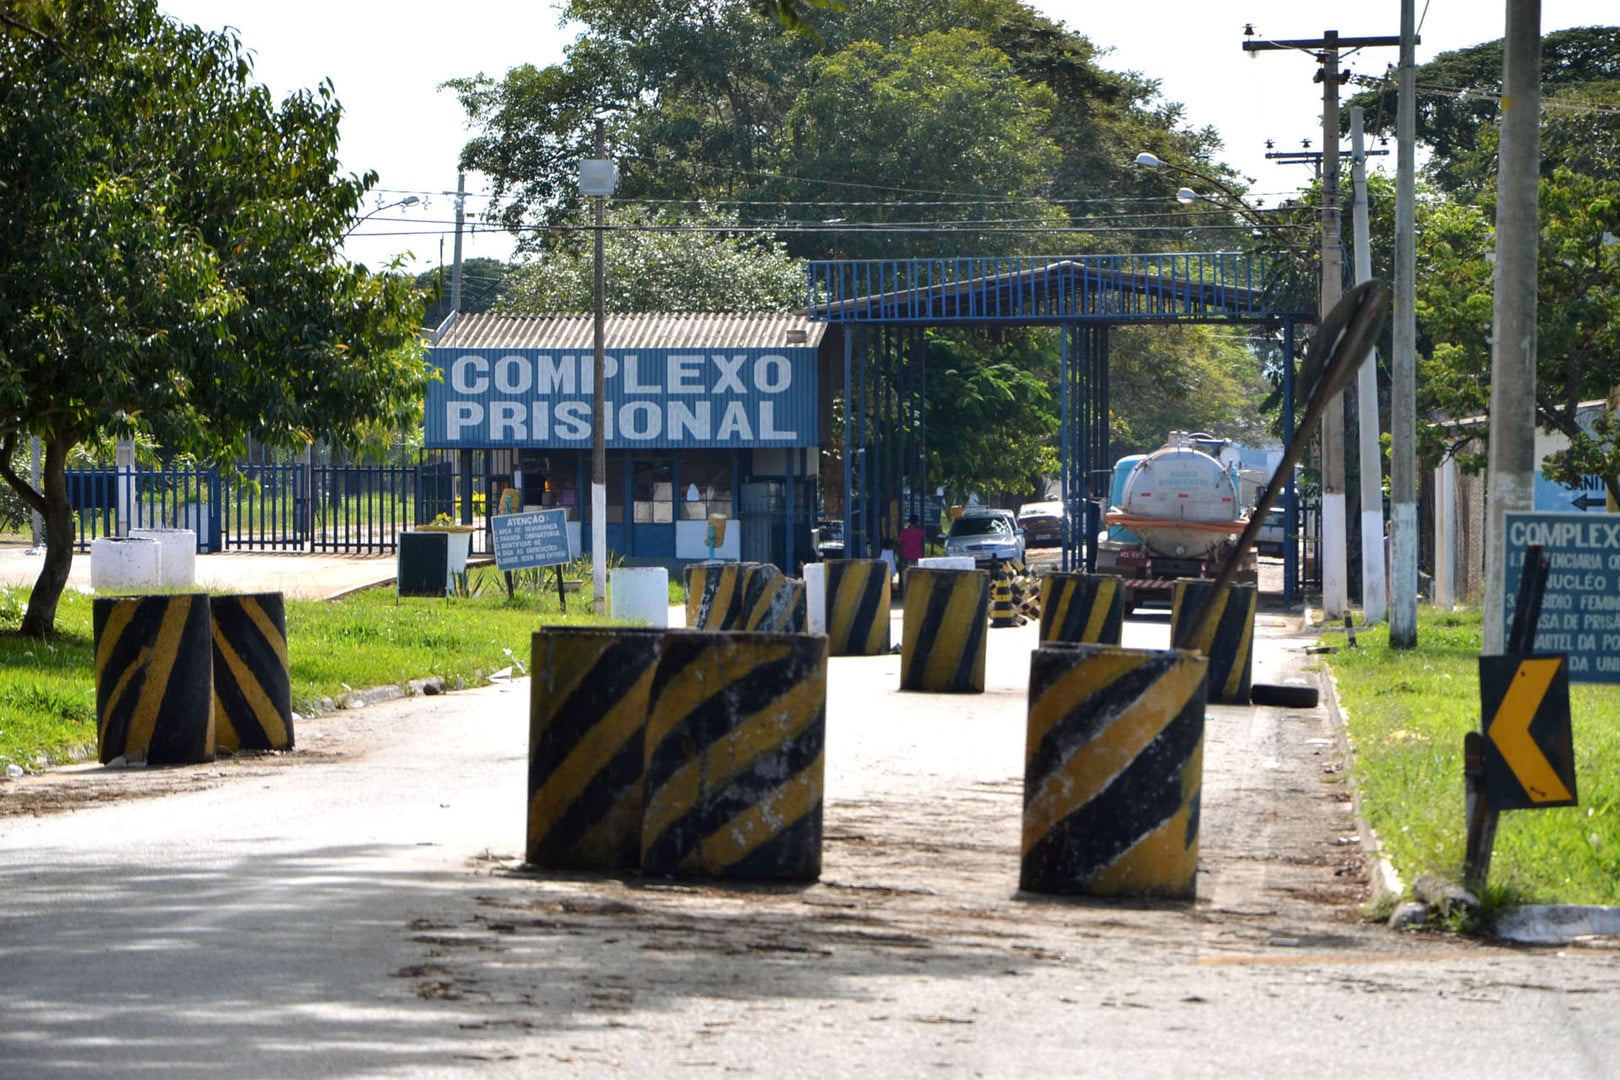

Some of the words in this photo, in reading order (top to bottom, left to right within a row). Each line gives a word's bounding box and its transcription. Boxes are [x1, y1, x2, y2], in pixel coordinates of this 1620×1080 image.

[452, 355, 792, 395] COMPLEXO
[446, 400, 798, 441] PRISIONAL
[1510, 522, 1620, 548] COMPLEX
[1563, 614, 1579, 630] DE
[1577, 634, 1596, 651] DA
[1569, 656, 1589, 671] DA
